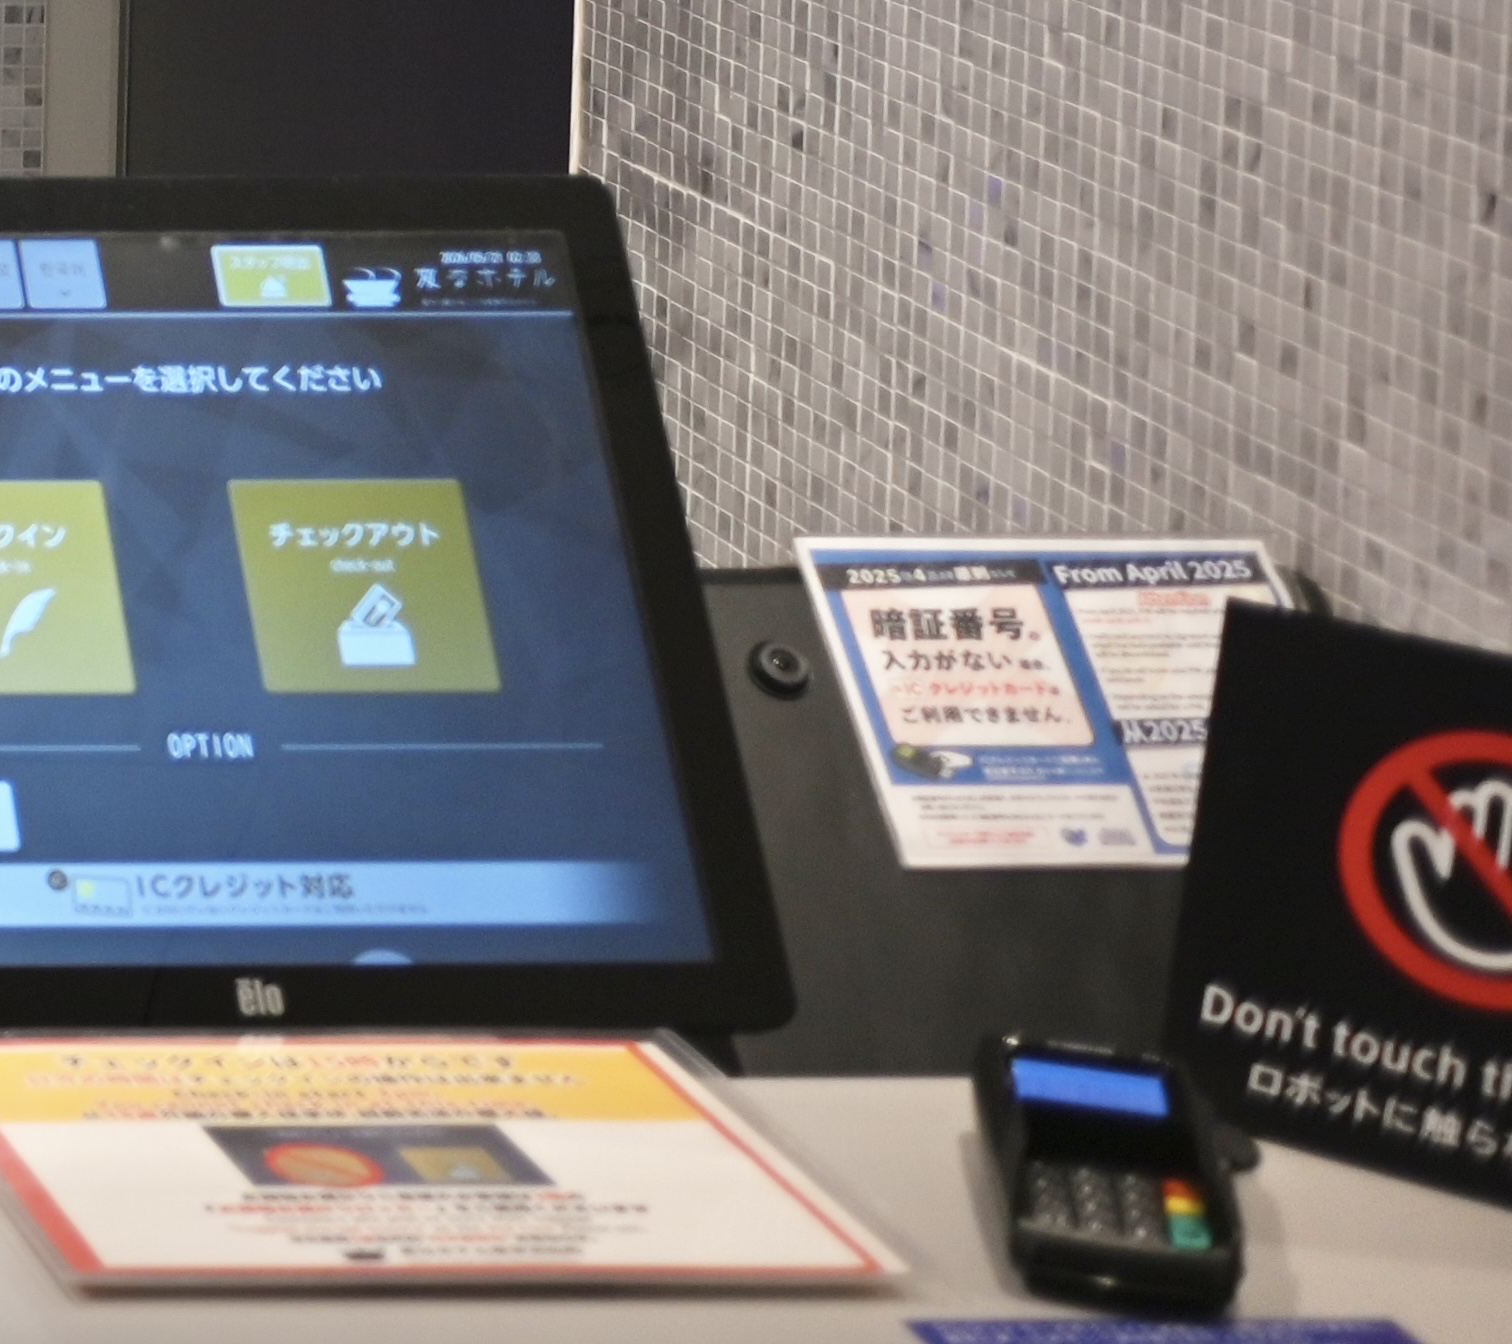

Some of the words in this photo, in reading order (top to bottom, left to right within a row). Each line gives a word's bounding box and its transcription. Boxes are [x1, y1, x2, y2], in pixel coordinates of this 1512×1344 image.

[269, 522, 440, 548] チェックアウト
[1053, 564, 1123, 584] From
[1125, 561, 1190, 584] April
[1188, 560, 1253, 579] 2025
[870, 608, 1040, 641] 暗証番号の
[167, 733, 254, 760] OPTION
[137, 874, 353, 899] ICクレジット対応
[1201, 983, 1321, 1050] Don't
[1334, 1021, 1468, 1089] touch
[1248, 1062, 1512, 1157] ロボットに触ら
